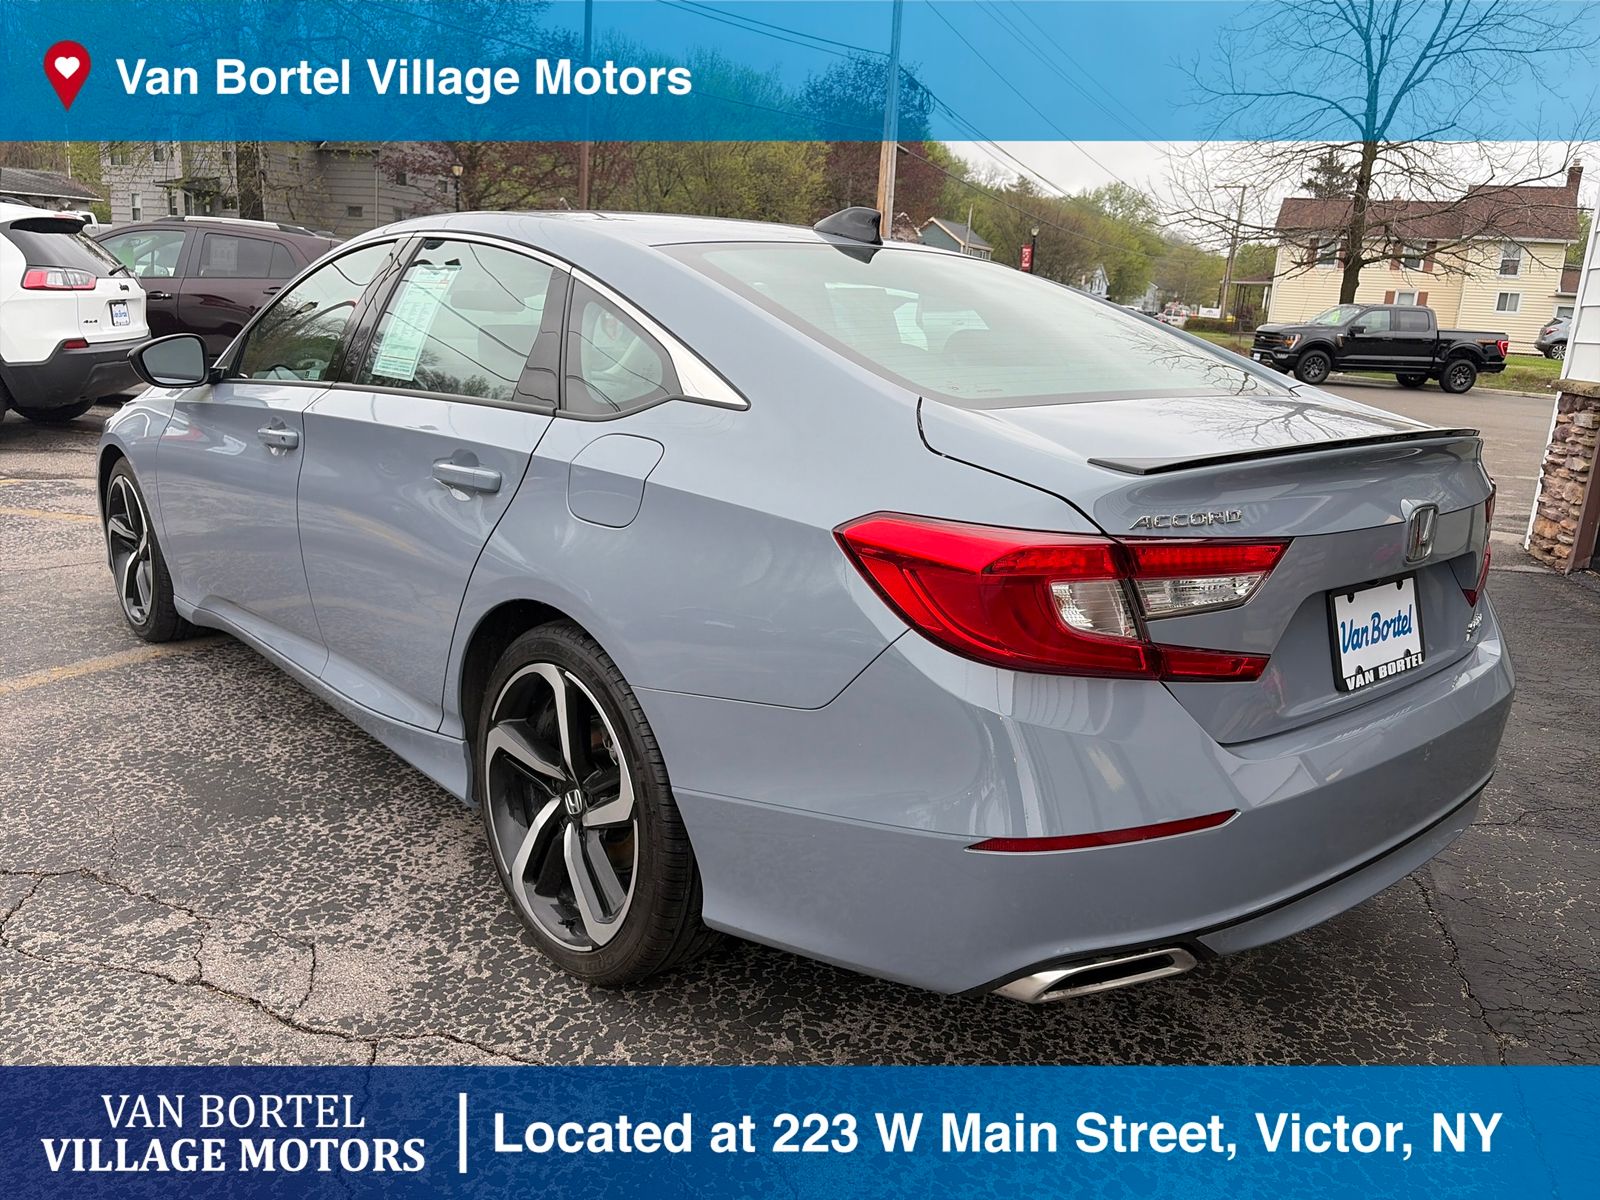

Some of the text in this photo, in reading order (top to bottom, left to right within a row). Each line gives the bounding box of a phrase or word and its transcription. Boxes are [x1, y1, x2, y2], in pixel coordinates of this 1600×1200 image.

[1128, 509, 1242, 530] ACCORD
[1345, 653, 1425, 691] VAN BORTEL
